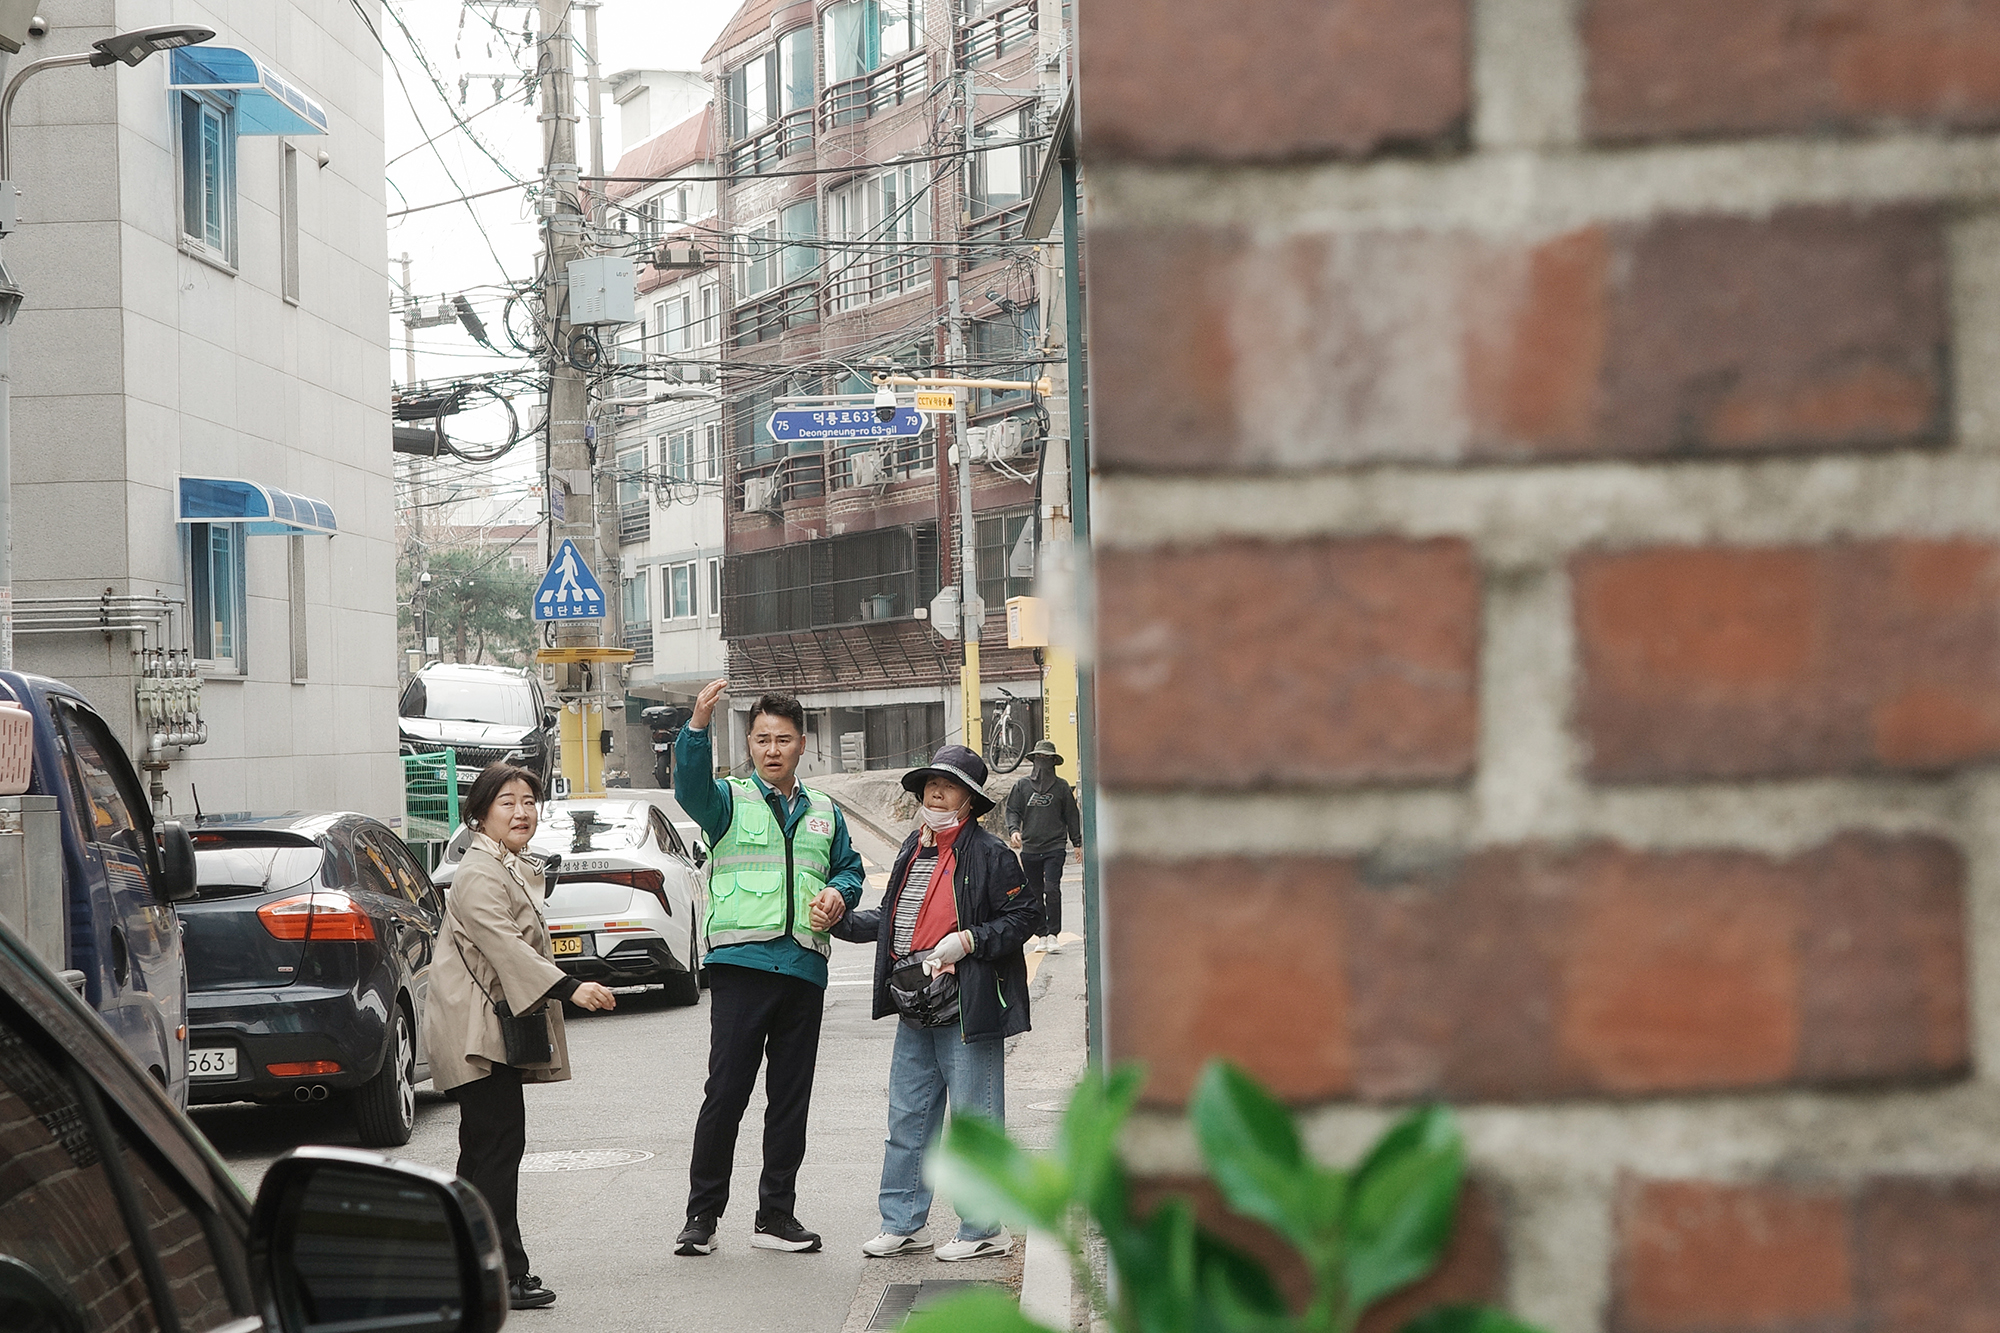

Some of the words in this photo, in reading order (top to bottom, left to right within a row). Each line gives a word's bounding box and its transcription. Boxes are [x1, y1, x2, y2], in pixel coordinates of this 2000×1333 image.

[918, 396, 933, 406] CCTV
[776, 420, 790, 431] 75
[905, 415, 918, 426] 79
[799, 428, 869, 438] Deongneung-ro
[871, 425, 897, 437] 63-gil
[543, 604, 600, 617] 횡단보도
[809, 819, 830, 835] 순찰
[559, 861, 589, 871] 성상운
[591, 861, 609, 869] 030
[552, 939, 576, 952] 130
[189, 1052, 225, 1072] 563
